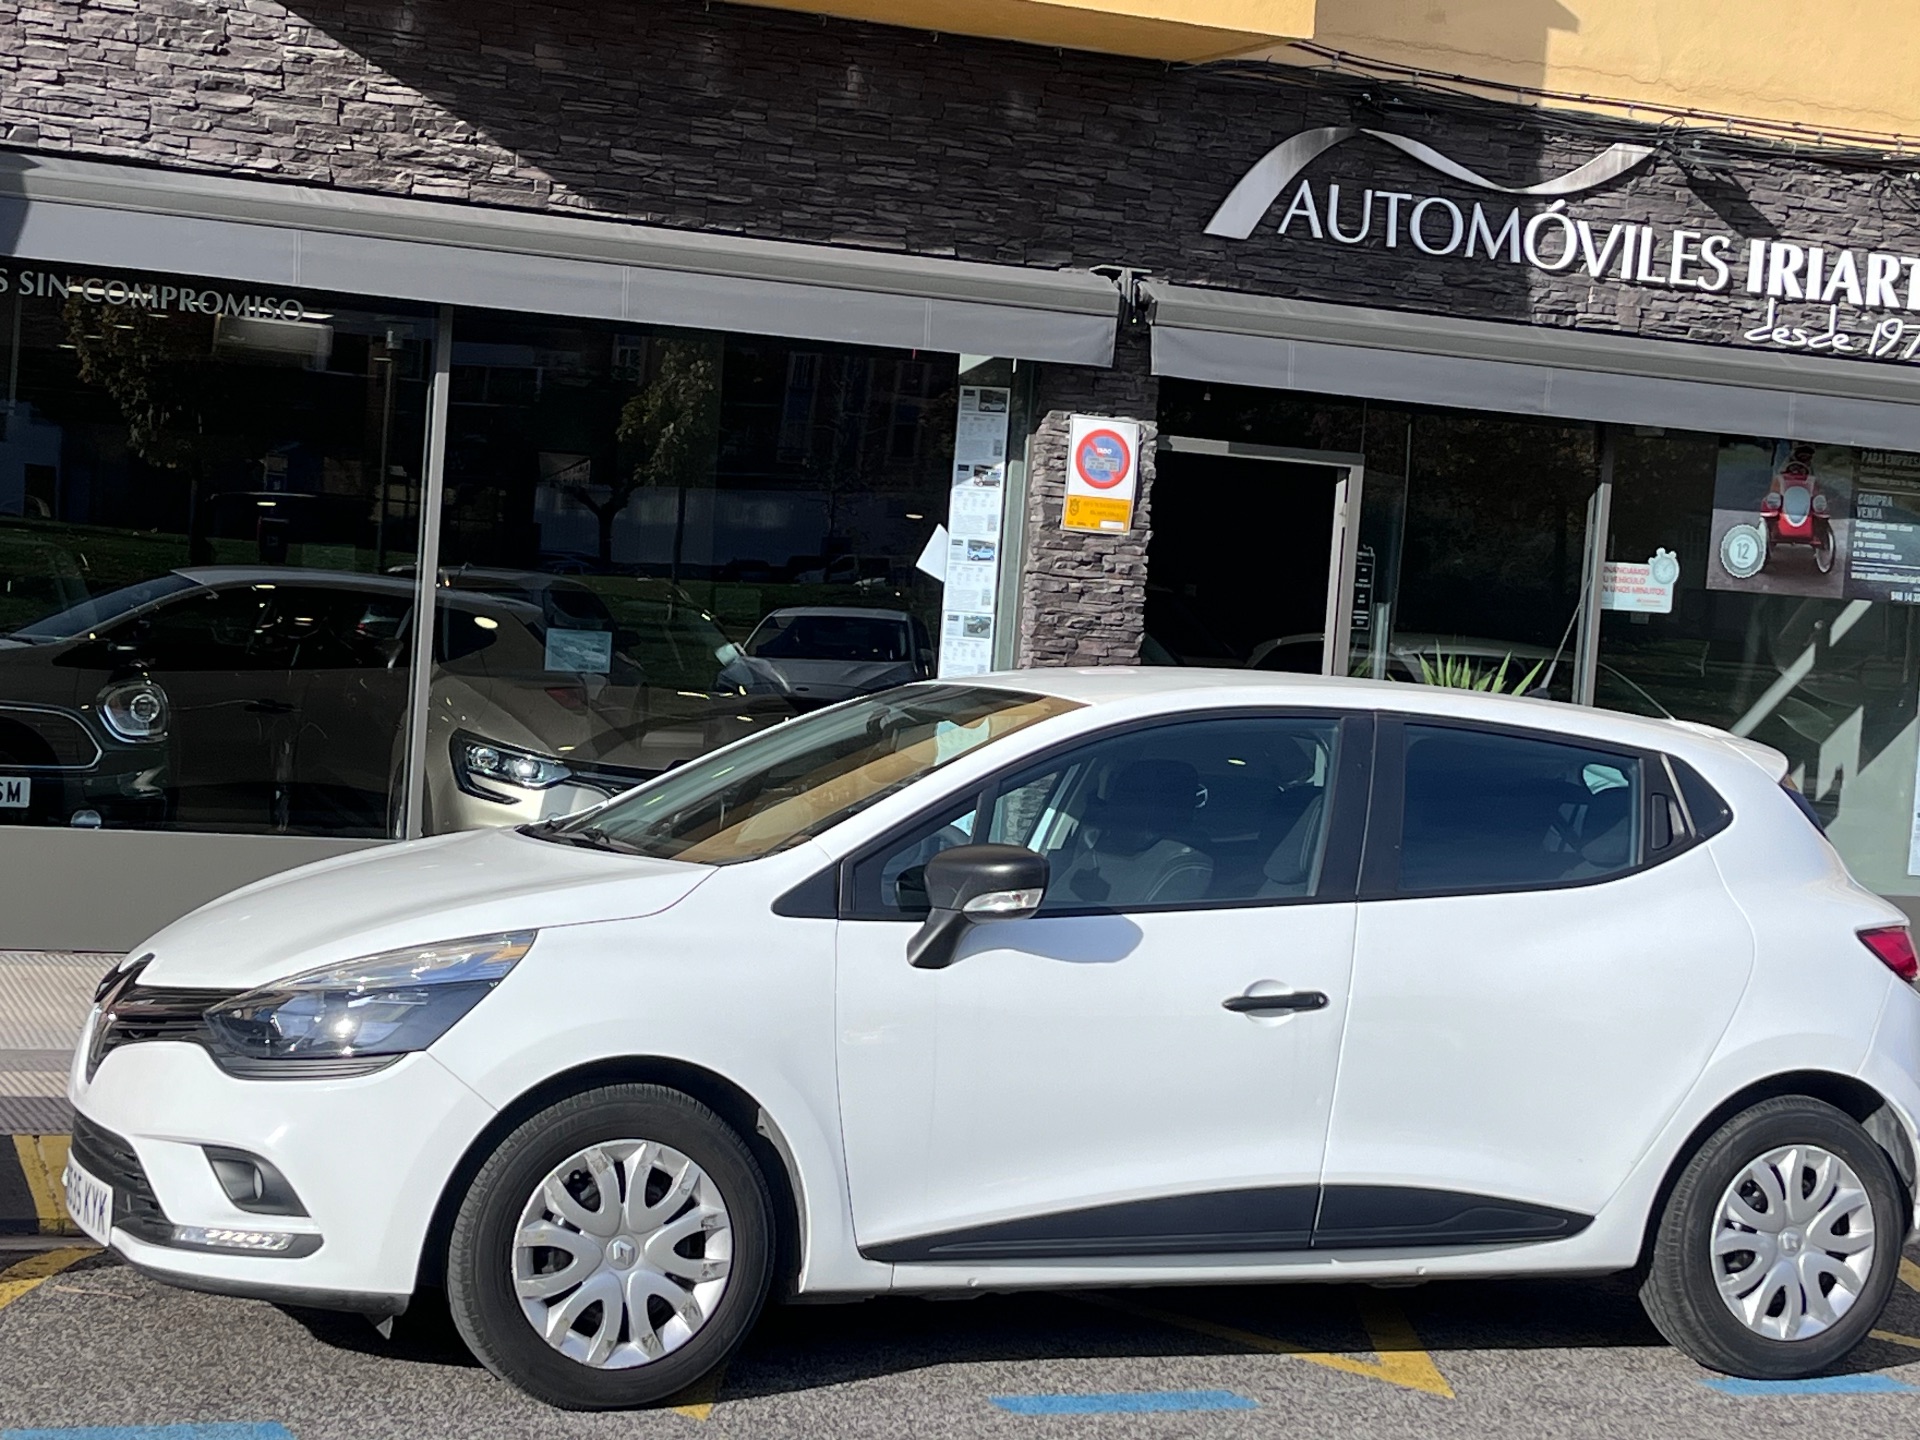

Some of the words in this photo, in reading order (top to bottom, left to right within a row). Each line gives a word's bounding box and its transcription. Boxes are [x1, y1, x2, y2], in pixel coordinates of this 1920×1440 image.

[1277, 178, 1732, 291] AUTOMÓVILES
[18, 270, 71, 299] SIN
[82, 278, 306, 323] COMPROMISO
[1743, 297, 1854, 352] desde
[1856, 507, 1882, 519] VENTA
[1857, 494, 1893, 507] COMPRA
[1736, 542, 1750, 560] 12
[83, 1181, 107, 1235] KYK
